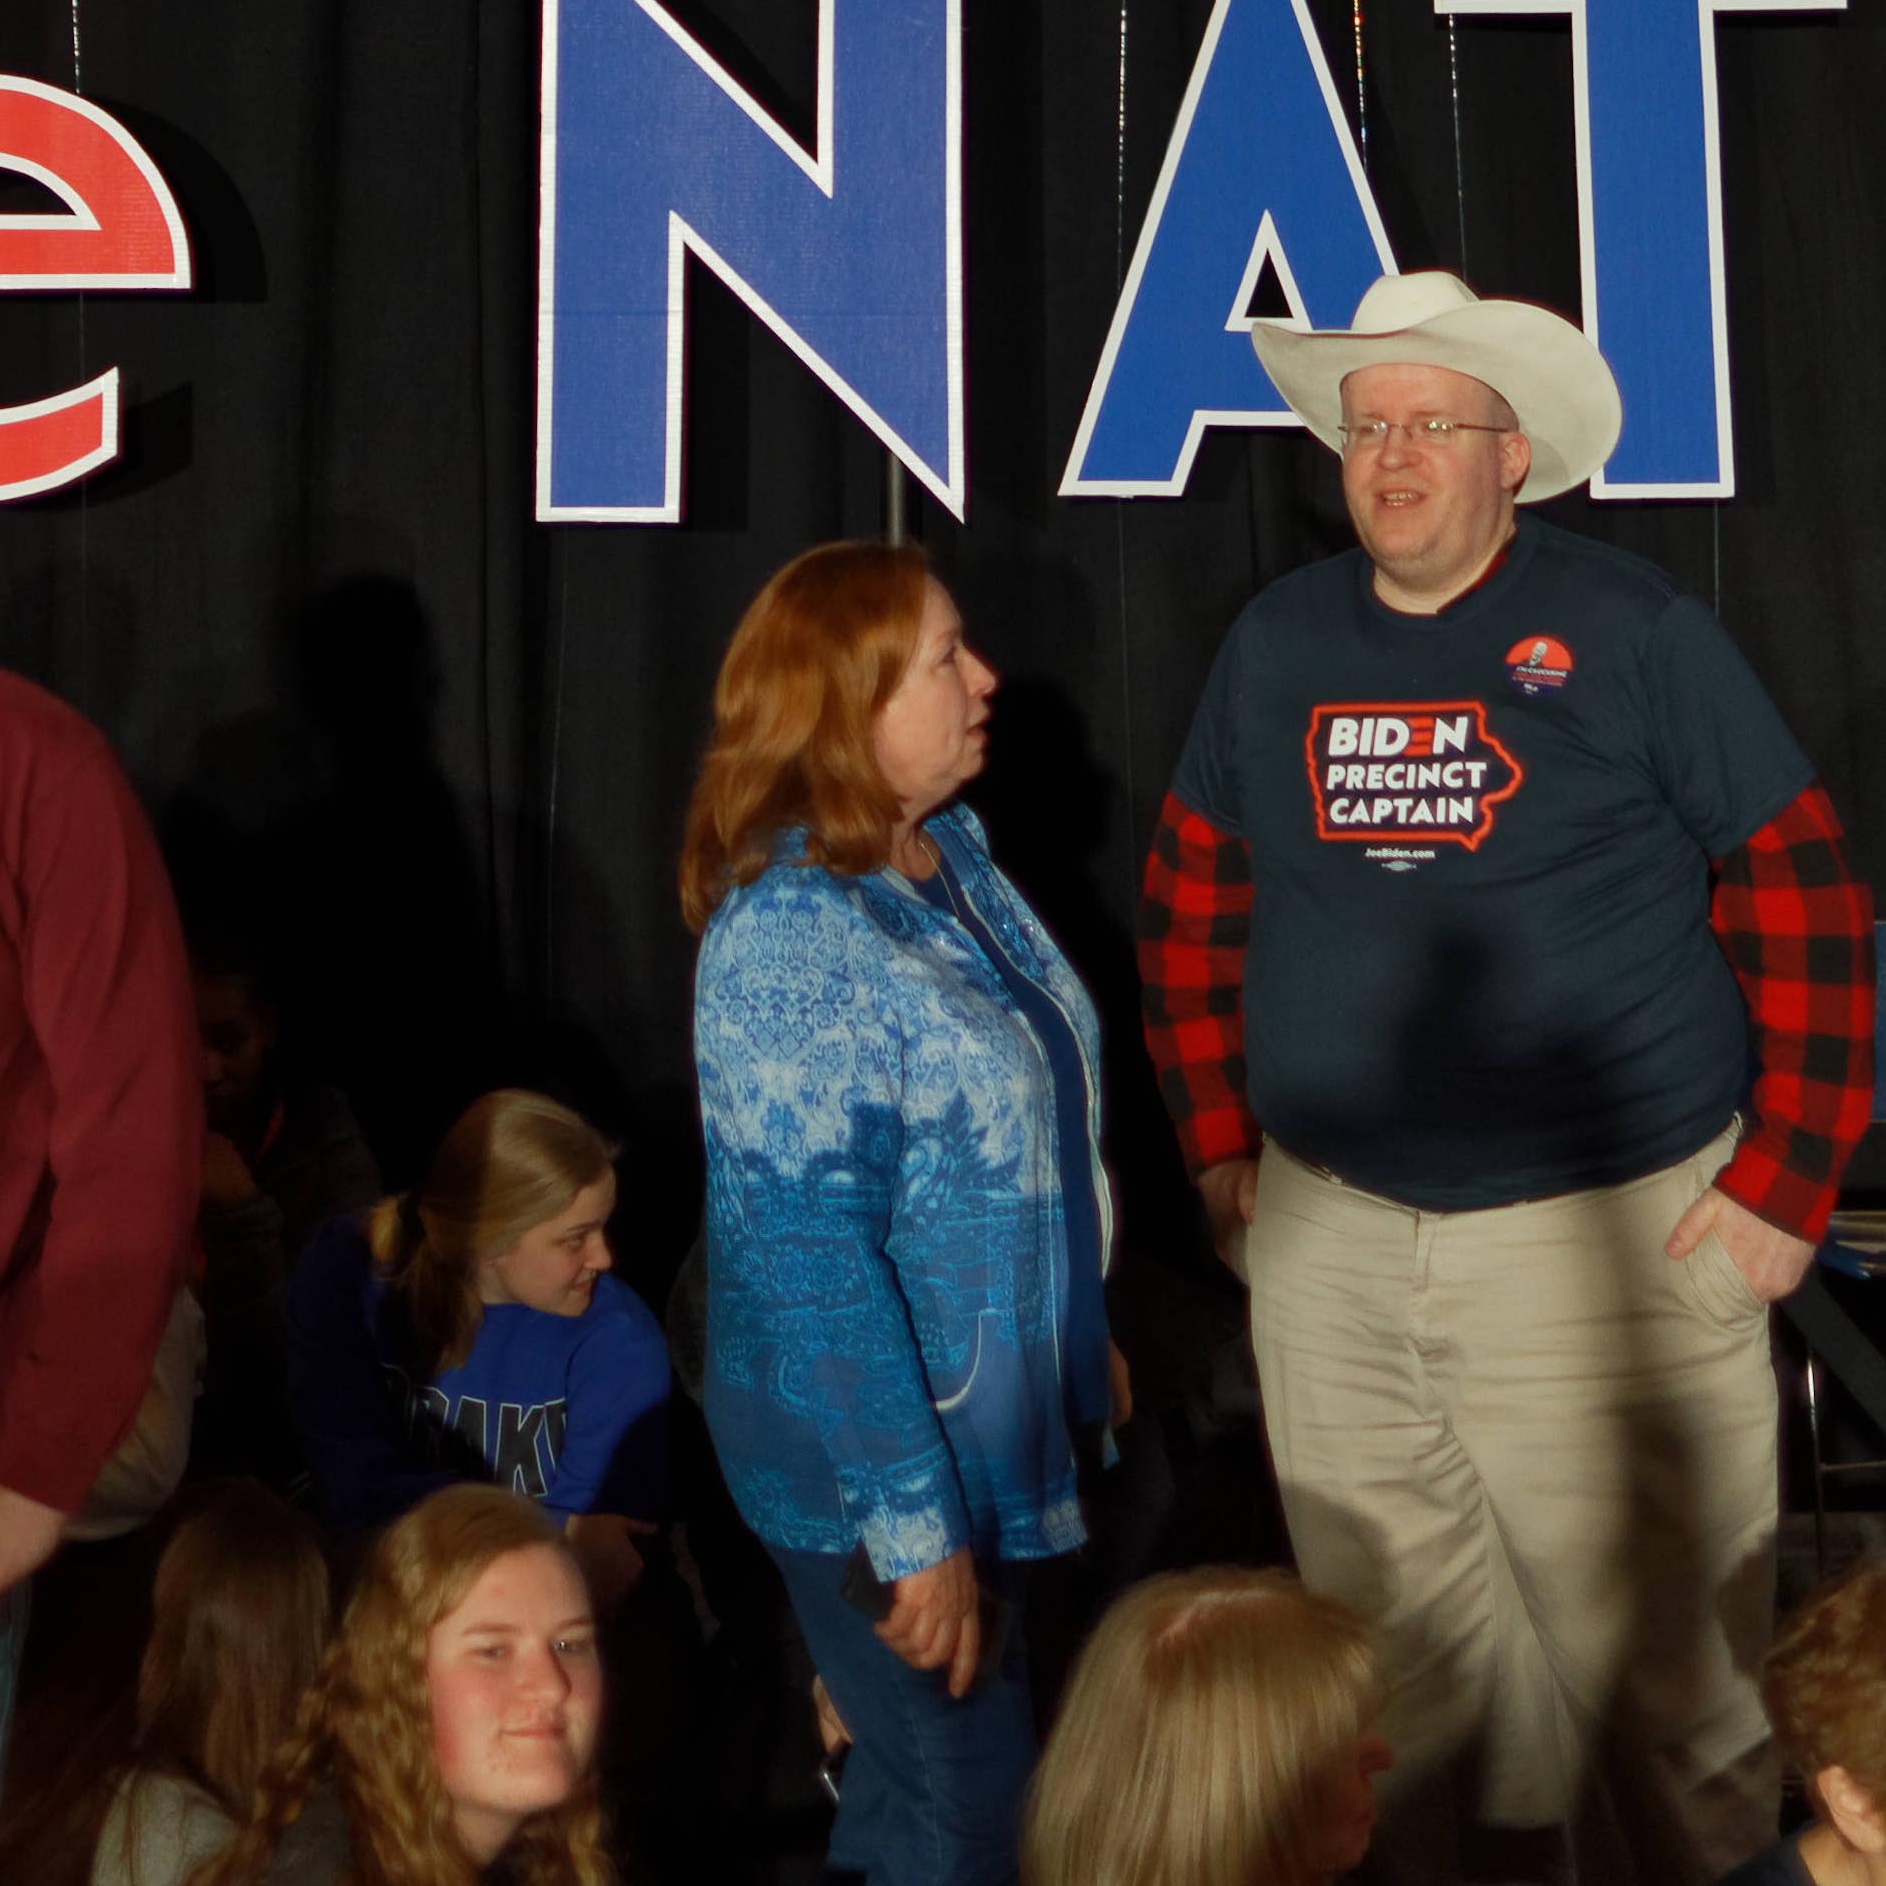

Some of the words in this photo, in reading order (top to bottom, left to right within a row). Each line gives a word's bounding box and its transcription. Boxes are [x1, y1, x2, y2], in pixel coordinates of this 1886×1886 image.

[1328, 716, 1469, 757] BIDEN
[1326, 761, 1487, 790] PRECINCT
[1329, 796, 1474, 824] CAPTAIN
